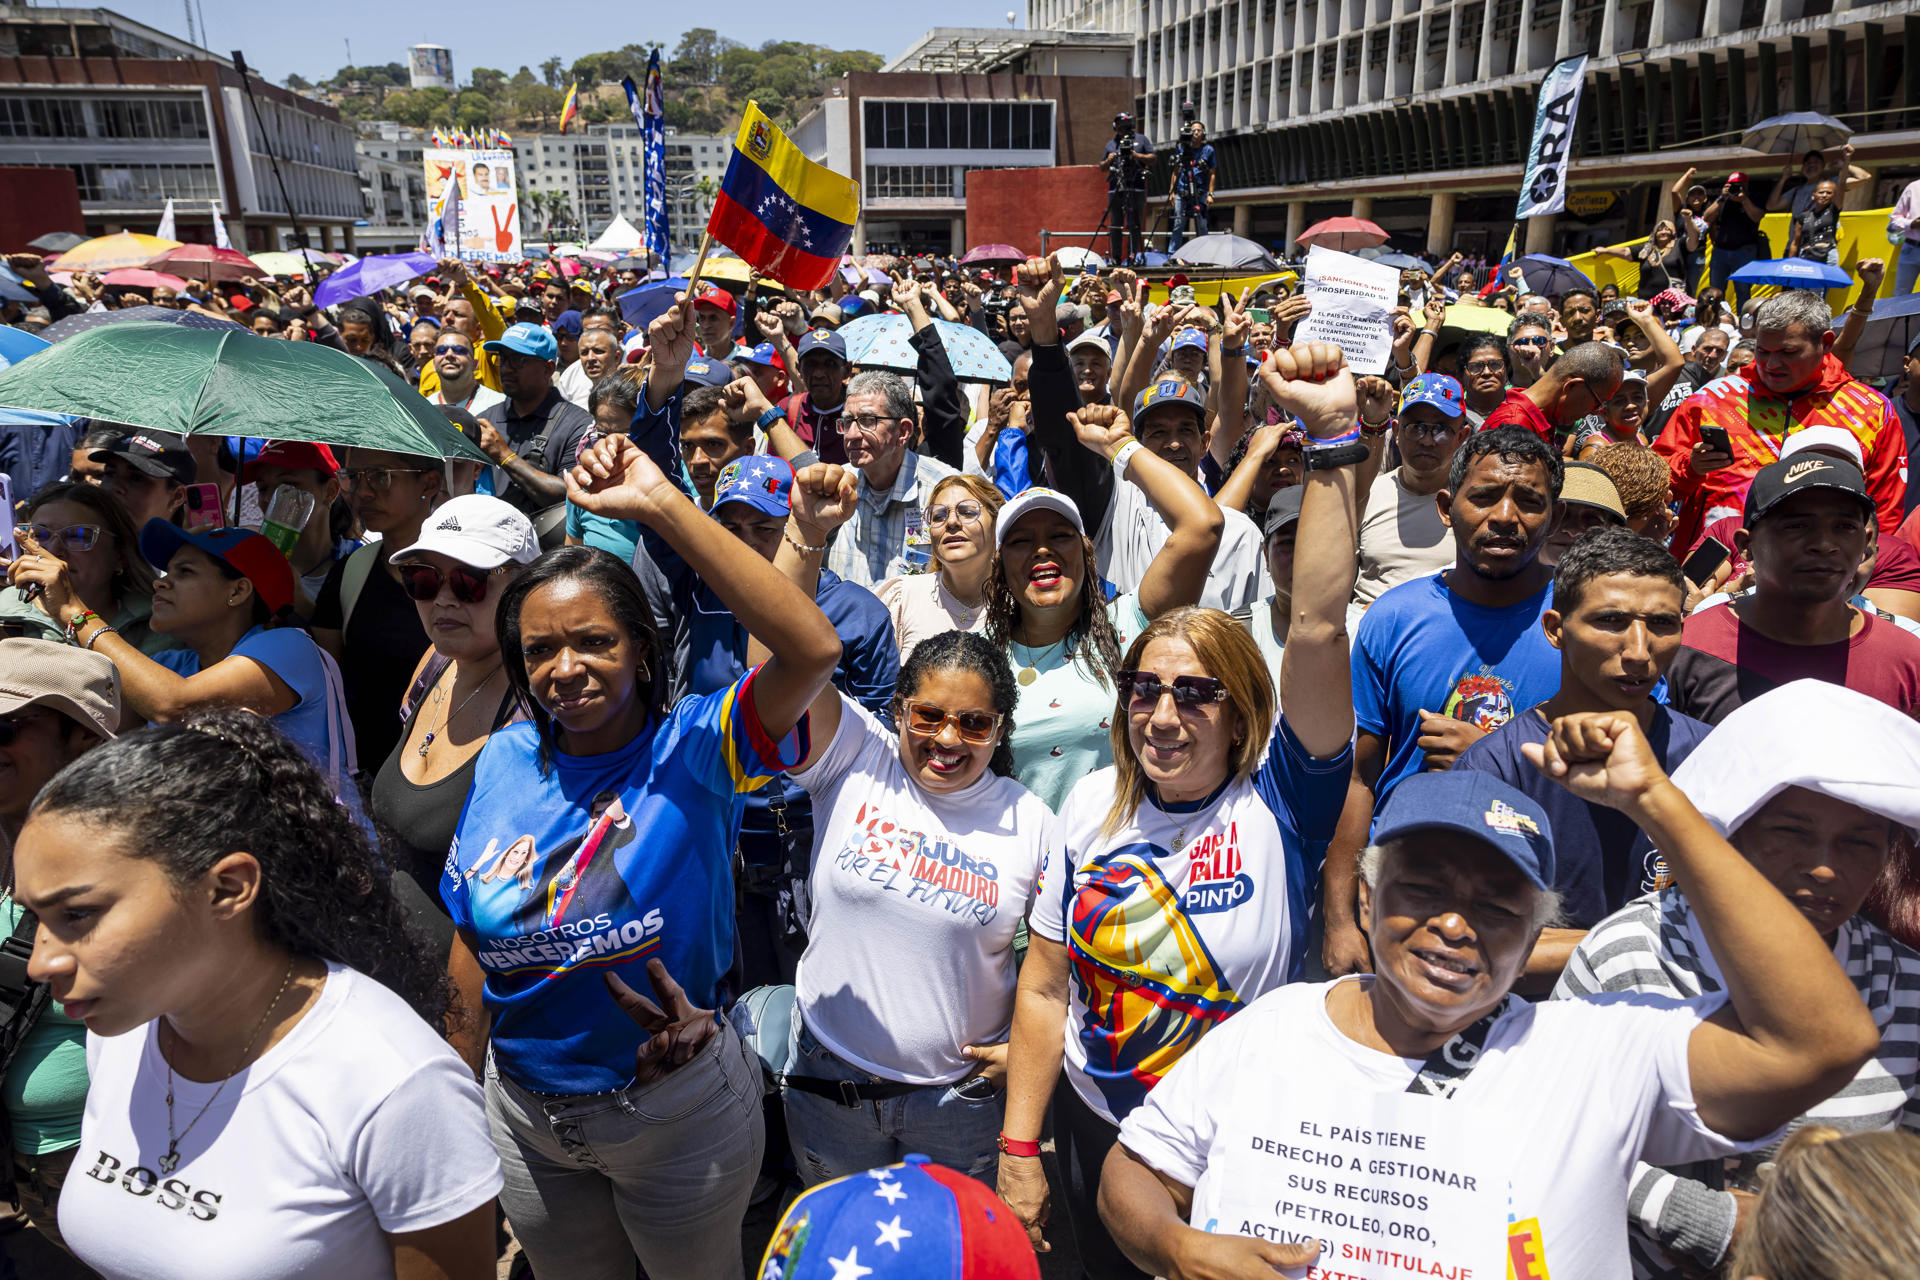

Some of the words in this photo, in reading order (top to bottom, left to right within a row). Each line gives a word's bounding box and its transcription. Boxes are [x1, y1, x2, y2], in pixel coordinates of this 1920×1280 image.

[1318, 327, 1368, 339] LEVANTAMIENTO
[1332, 337, 1366, 347] SANCIONES
[1335, 321, 1376, 332] CRECIMIENTO
[761, 476, 781, 494] 4F
[1789, 460, 1824, 476] NIKE
[922, 841, 998, 881] JURO
[834, 846, 870, 877] POR
[868, 862, 900, 892] EL
[906, 876, 998, 926] FUTURO
[914, 854, 999, 909] MADURO
[1186, 879, 1245, 909] PINTO
[479, 907, 664, 969] VENCEREMOS
[488, 912, 612, 950] NOSOTROS
[1299, 1120, 1323, 1138] EL
[1329, 1125, 1373, 1145] PAÍS
[1376, 1131, 1427, 1151] TIENE
[1251, 1136, 1344, 1169] DERECHO
[1350, 1157, 1363, 1173] A
[1368, 1159, 1477, 1192] GESTIONAR
[86, 1149, 223, 1222] BOSS
[1287, 1173, 1327, 1194] SUS
[1333, 1183, 1429, 1212] RECURSOS
[1275, 1199, 1385, 1236] (PETROLEO,
[1388, 1221, 1437, 1248] ORO,
[1341, 1243, 1372, 1263] SIN
[1376, 1249, 1473, 1280] TITULAJE
